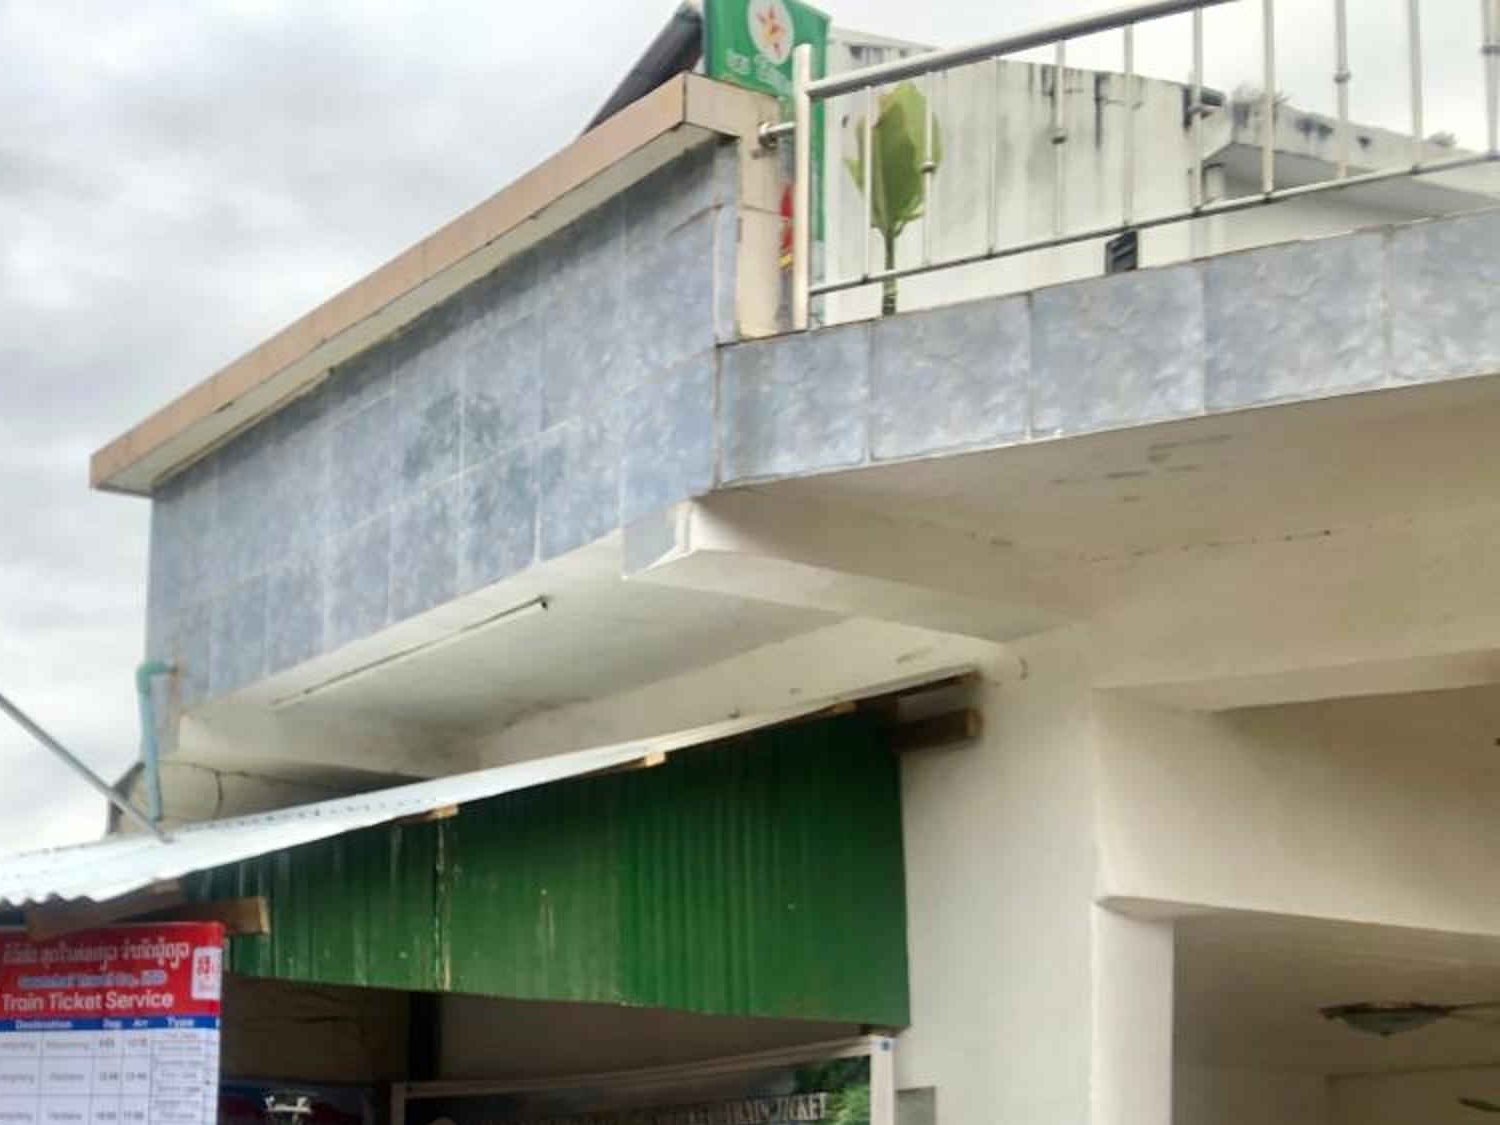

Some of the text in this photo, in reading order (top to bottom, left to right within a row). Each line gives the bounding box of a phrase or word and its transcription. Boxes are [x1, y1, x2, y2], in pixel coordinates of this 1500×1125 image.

[3, 989, 174, 1012] Train Ticket Service
